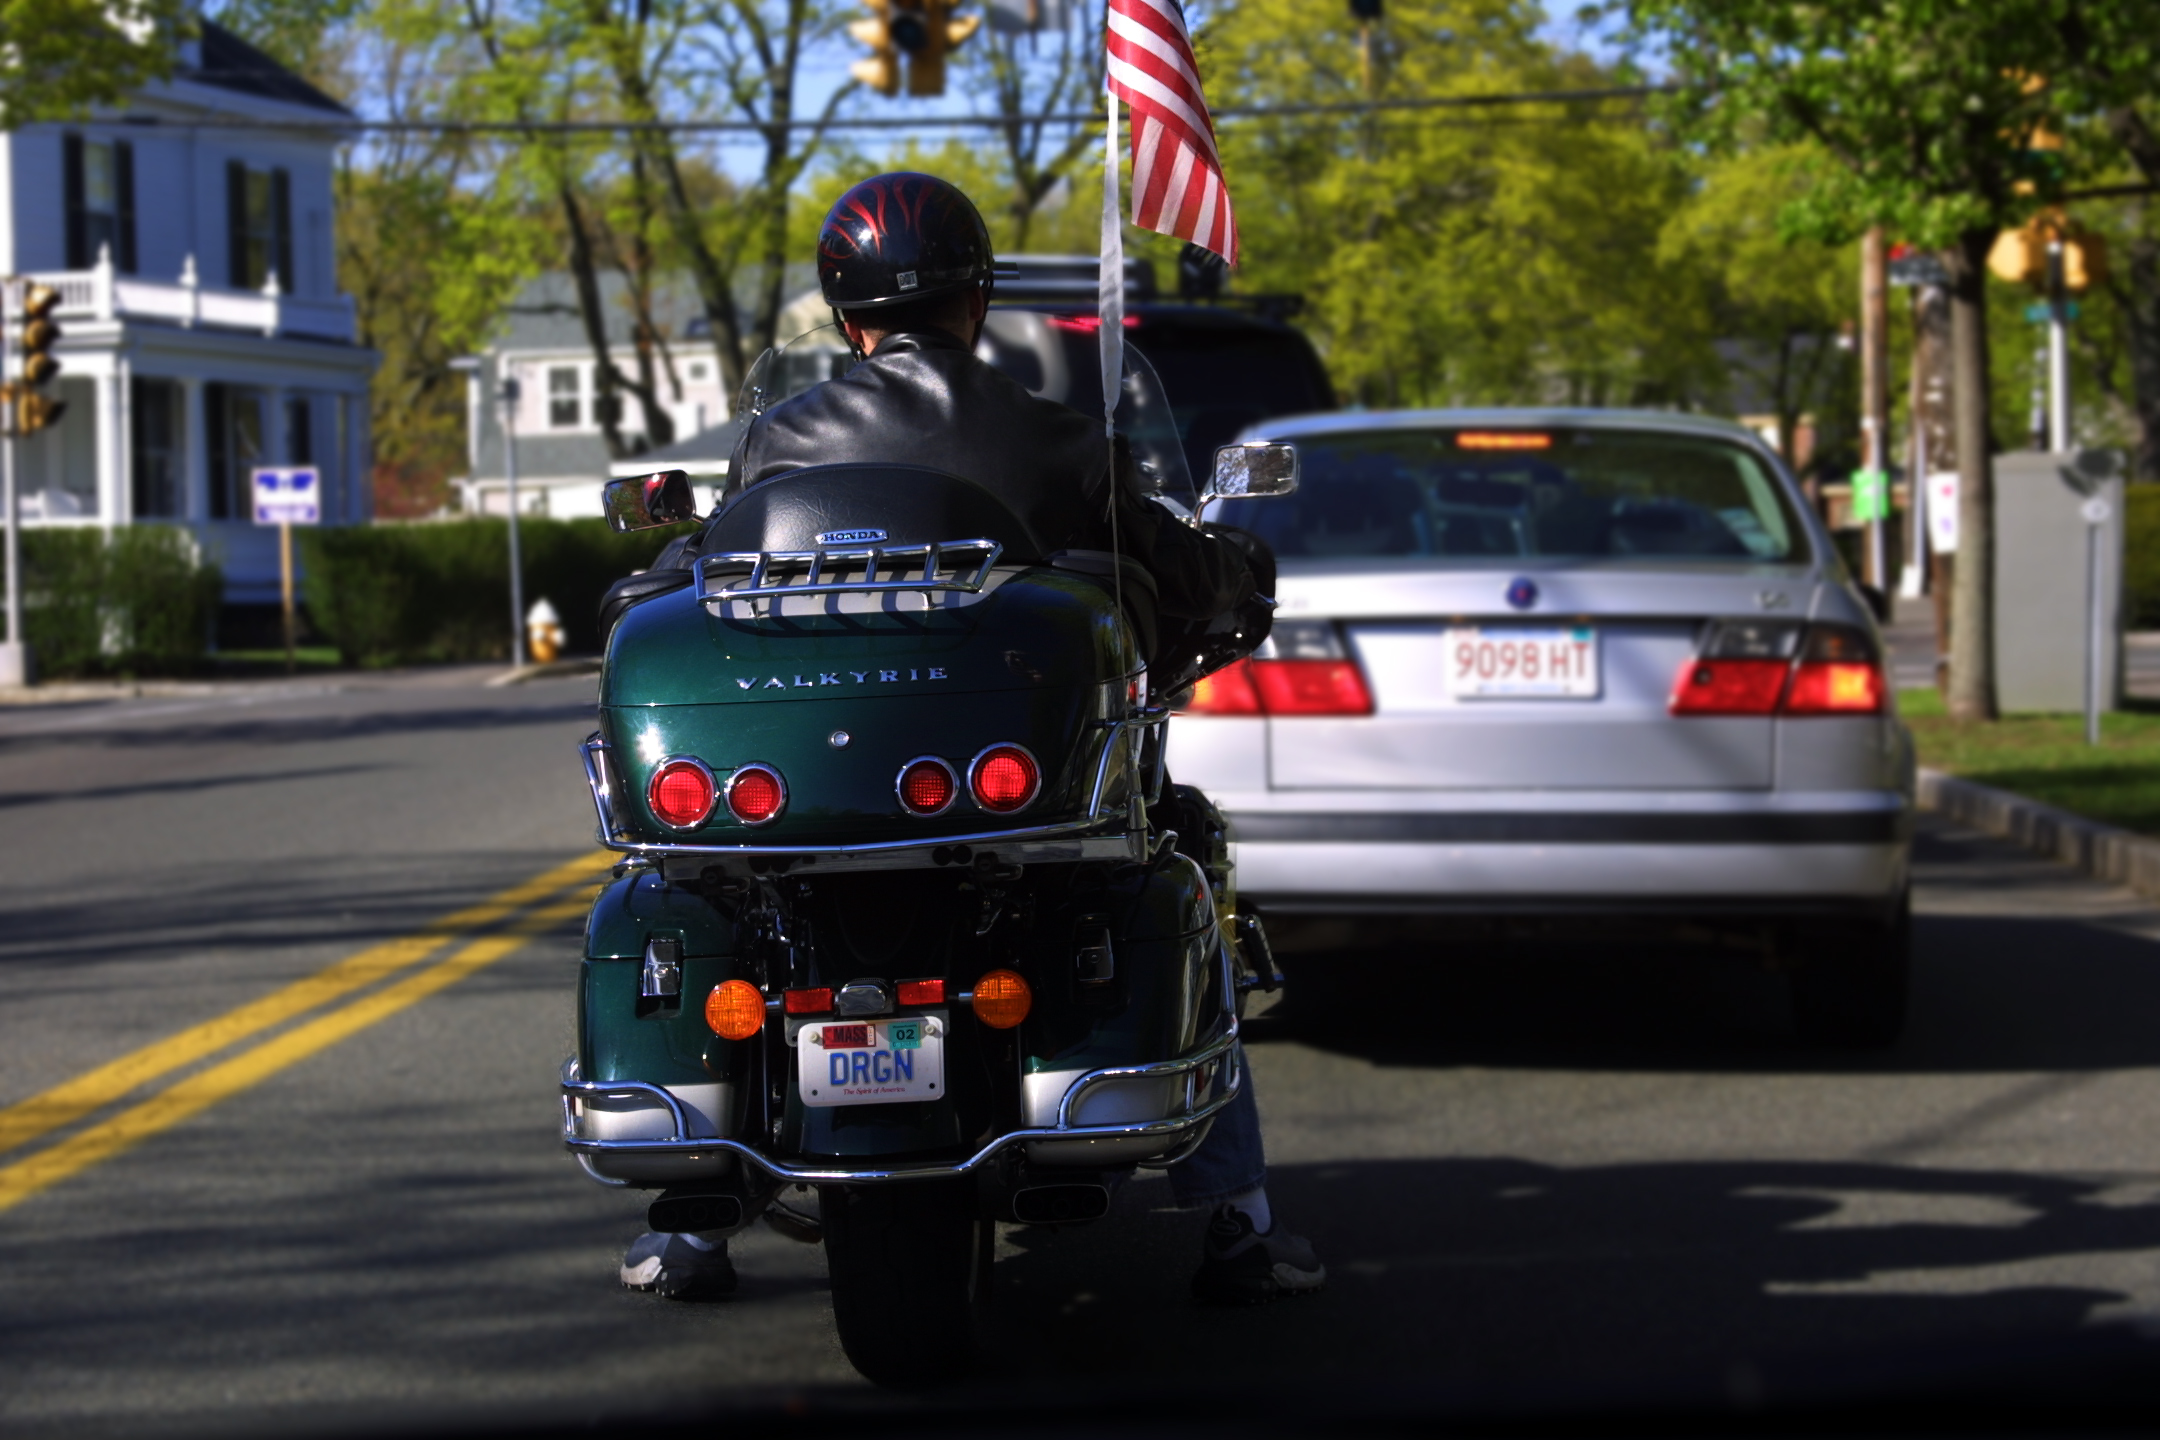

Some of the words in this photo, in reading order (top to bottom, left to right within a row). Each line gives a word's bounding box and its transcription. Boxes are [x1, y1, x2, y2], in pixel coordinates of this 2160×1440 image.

[824, 531, 879, 541] HONDA
[1455, 642, 1541, 679] 9098
[1550, 643, 1588, 678] HT
[735, 667, 948, 690] VALKYRIE
[833, 1026, 866, 1043] MASS
[896, 1029, 915, 1041] 02
[830, 1050, 912, 1085] DRGN
